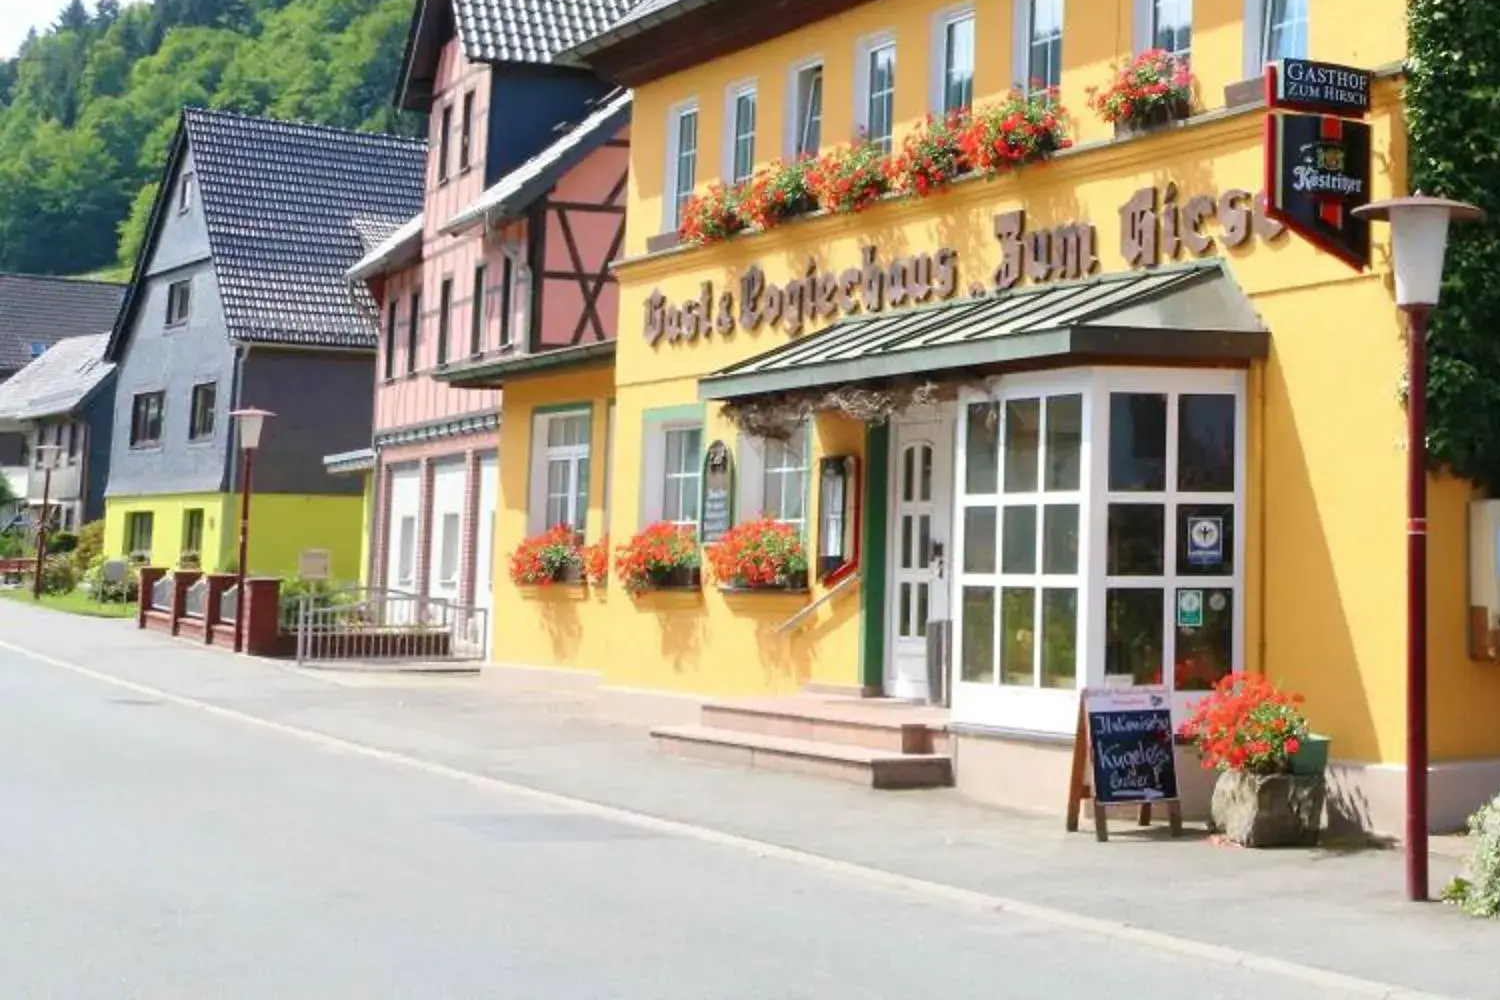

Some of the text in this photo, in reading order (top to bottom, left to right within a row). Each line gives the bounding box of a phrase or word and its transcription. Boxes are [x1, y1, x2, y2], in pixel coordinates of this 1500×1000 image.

[1287, 63, 1367, 91] GASTHOF
[1287, 81, 1367, 106] ZUM HIRSCH
